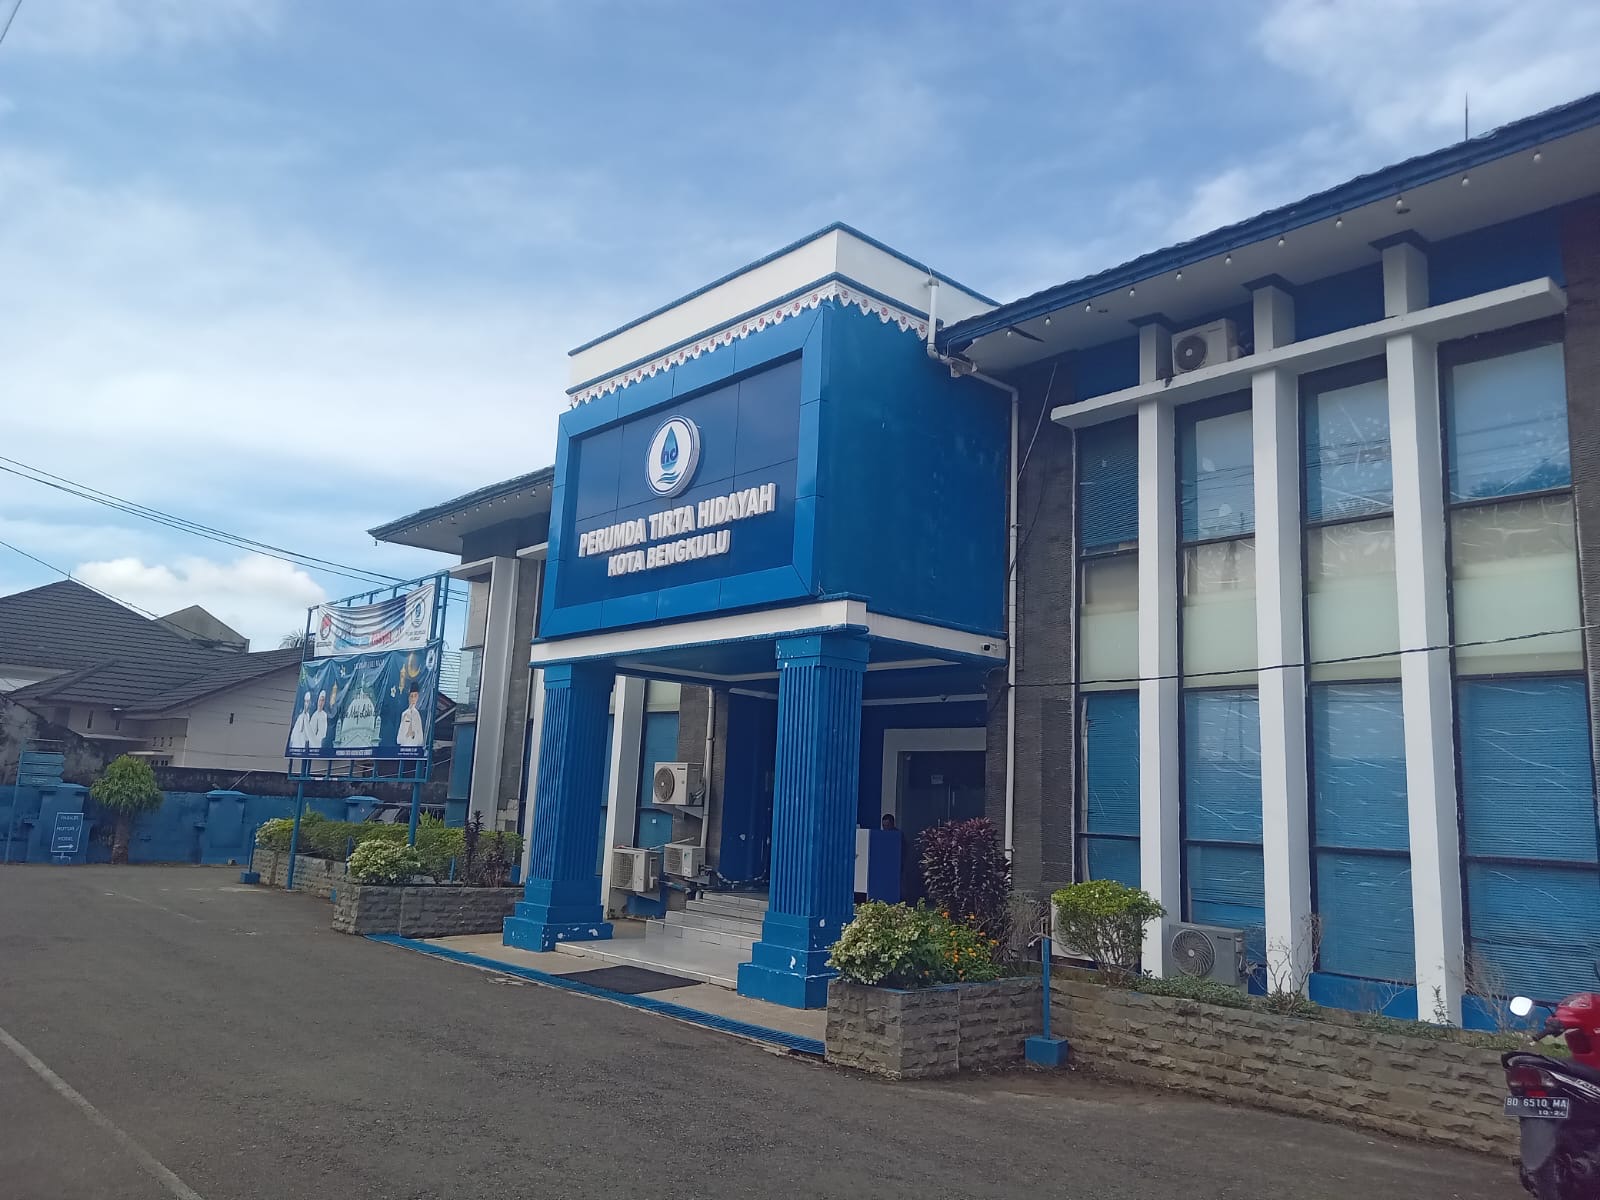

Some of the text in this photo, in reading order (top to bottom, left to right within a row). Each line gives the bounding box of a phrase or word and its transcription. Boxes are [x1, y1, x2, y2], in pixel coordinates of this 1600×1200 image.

[578, 483, 776, 557] PERUMDA TIRTA HIDAYAH
[607, 530, 731, 577] KOTA BENGKULU
[1506, 1097, 1567, 1108] BD 6510 MA
